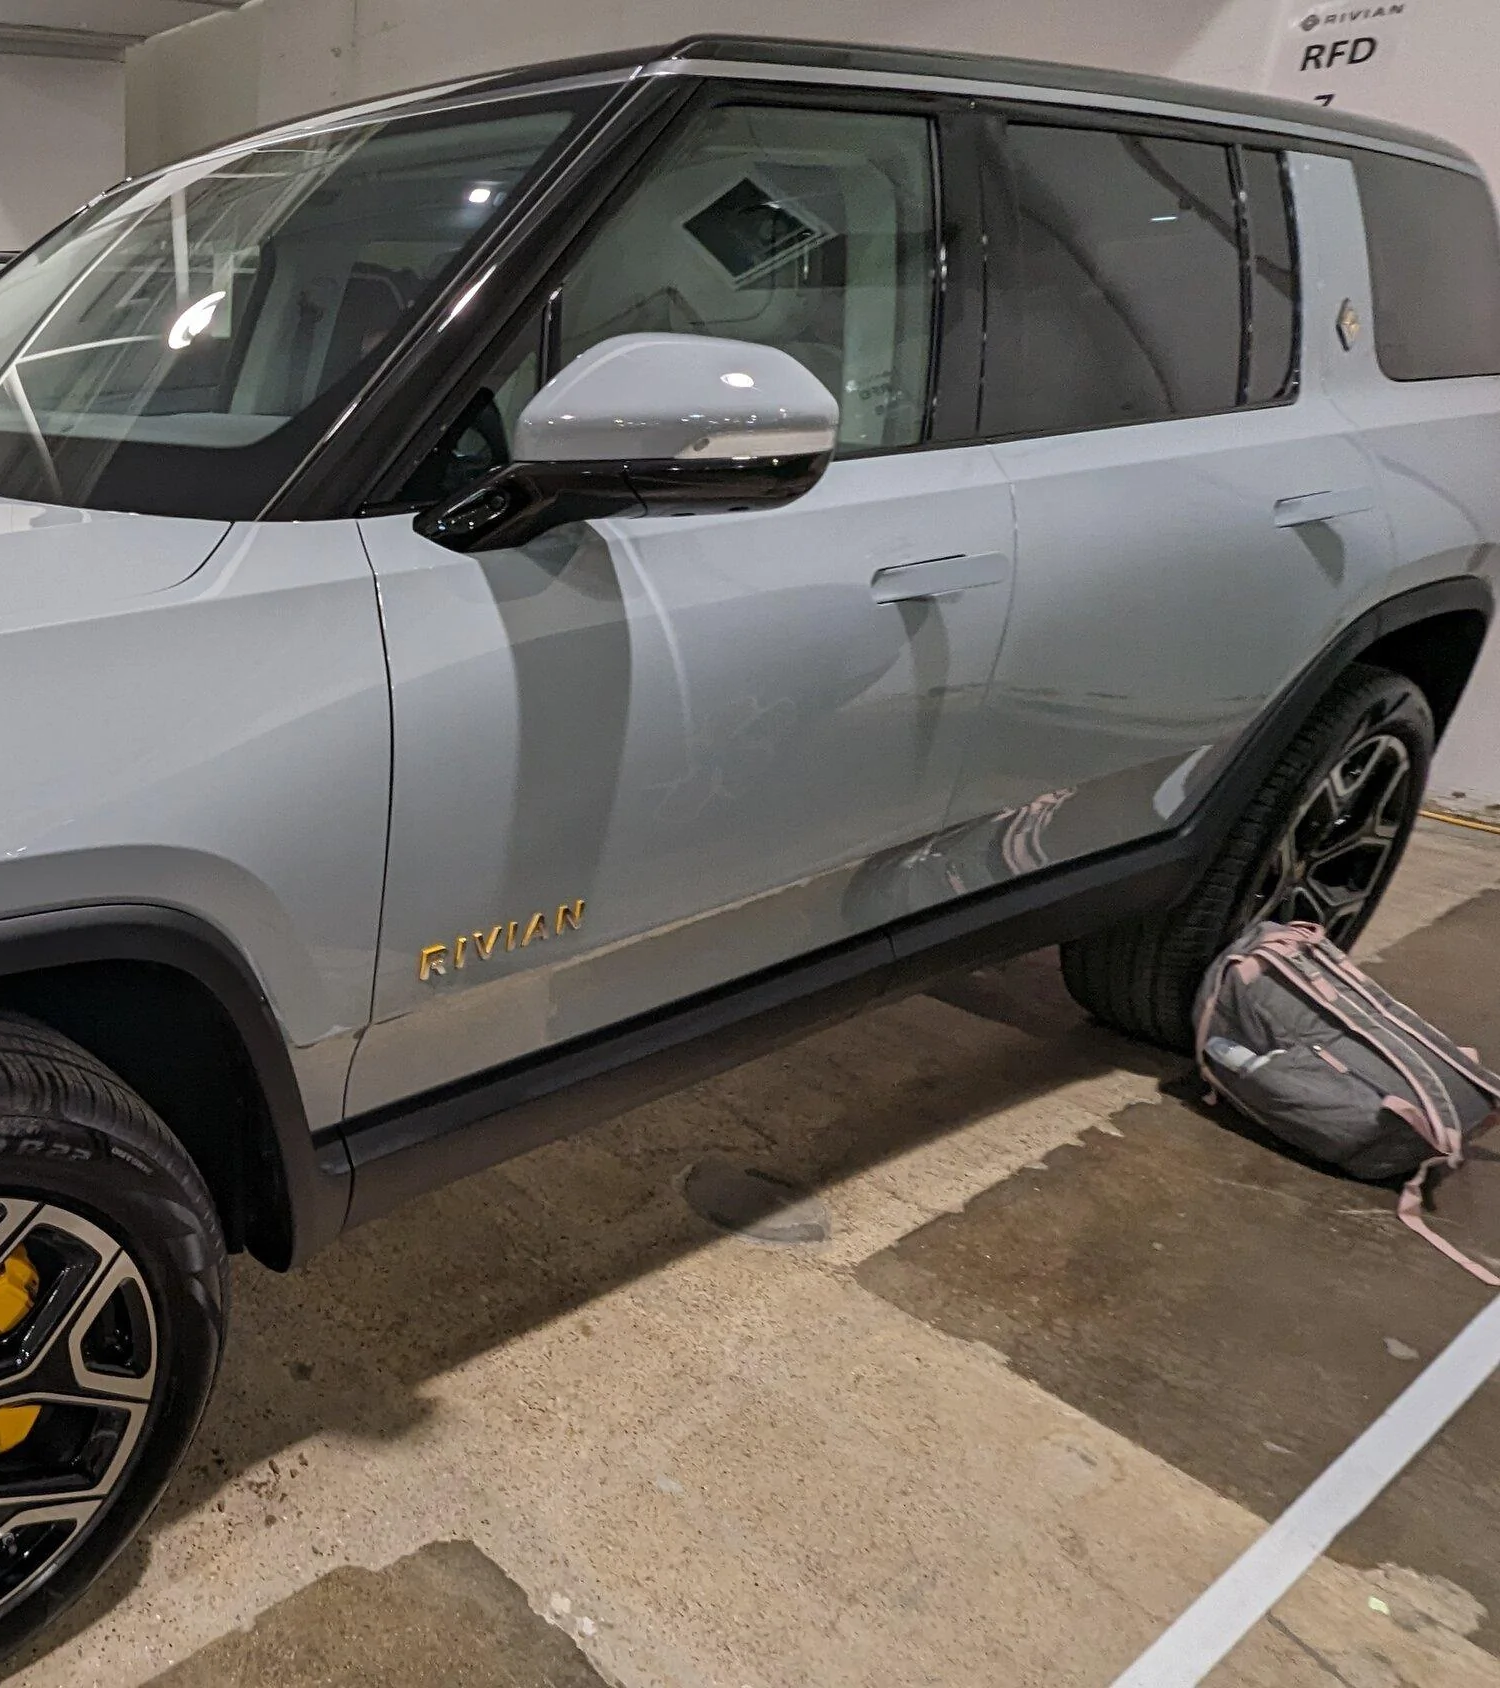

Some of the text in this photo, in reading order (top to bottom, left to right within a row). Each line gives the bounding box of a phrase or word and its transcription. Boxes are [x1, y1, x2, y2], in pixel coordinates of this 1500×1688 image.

[1324, 4, 1404, 25] RIVIAN
[1300, 37, 1377, 71] RFD
[419, 899, 585, 981] RIVIAN
